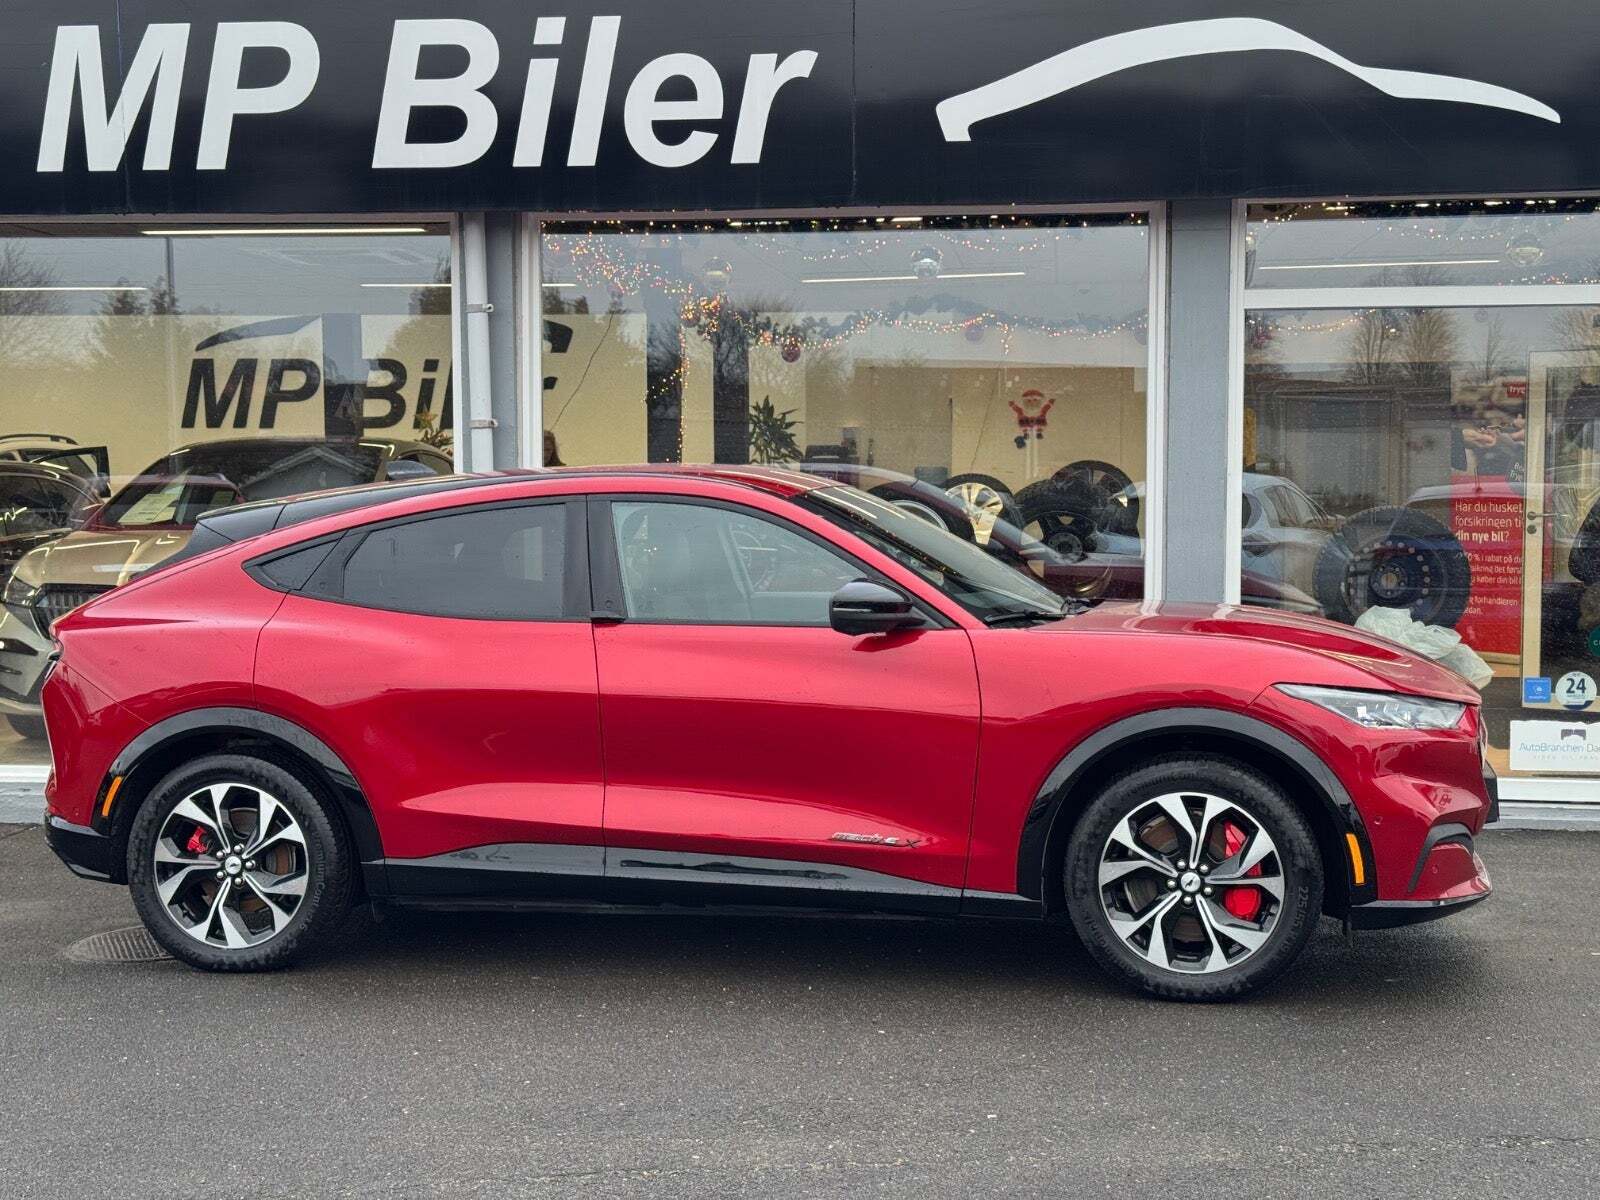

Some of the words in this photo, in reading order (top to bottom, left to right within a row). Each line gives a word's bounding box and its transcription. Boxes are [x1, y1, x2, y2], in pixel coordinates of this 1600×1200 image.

[36, 22, 321, 172] MP
[371, 15, 818, 169] Biler
[181, 358, 321, 429] MP
[1455, 501, 1472, 511] Har
[1474, 501, 1487, 512] du
[1489, 501, 1523, 513] husket
[1455, 515, 1512, 529] forsikringen
[1455, 530, 1470, 541] din
[1472, 532, 1489, 544] nye
[1491, 530, 1510, 542] bil?
[1566, 678, 1587, 694] 24
[1518, 742, 1584, 753] AutoBranchen
